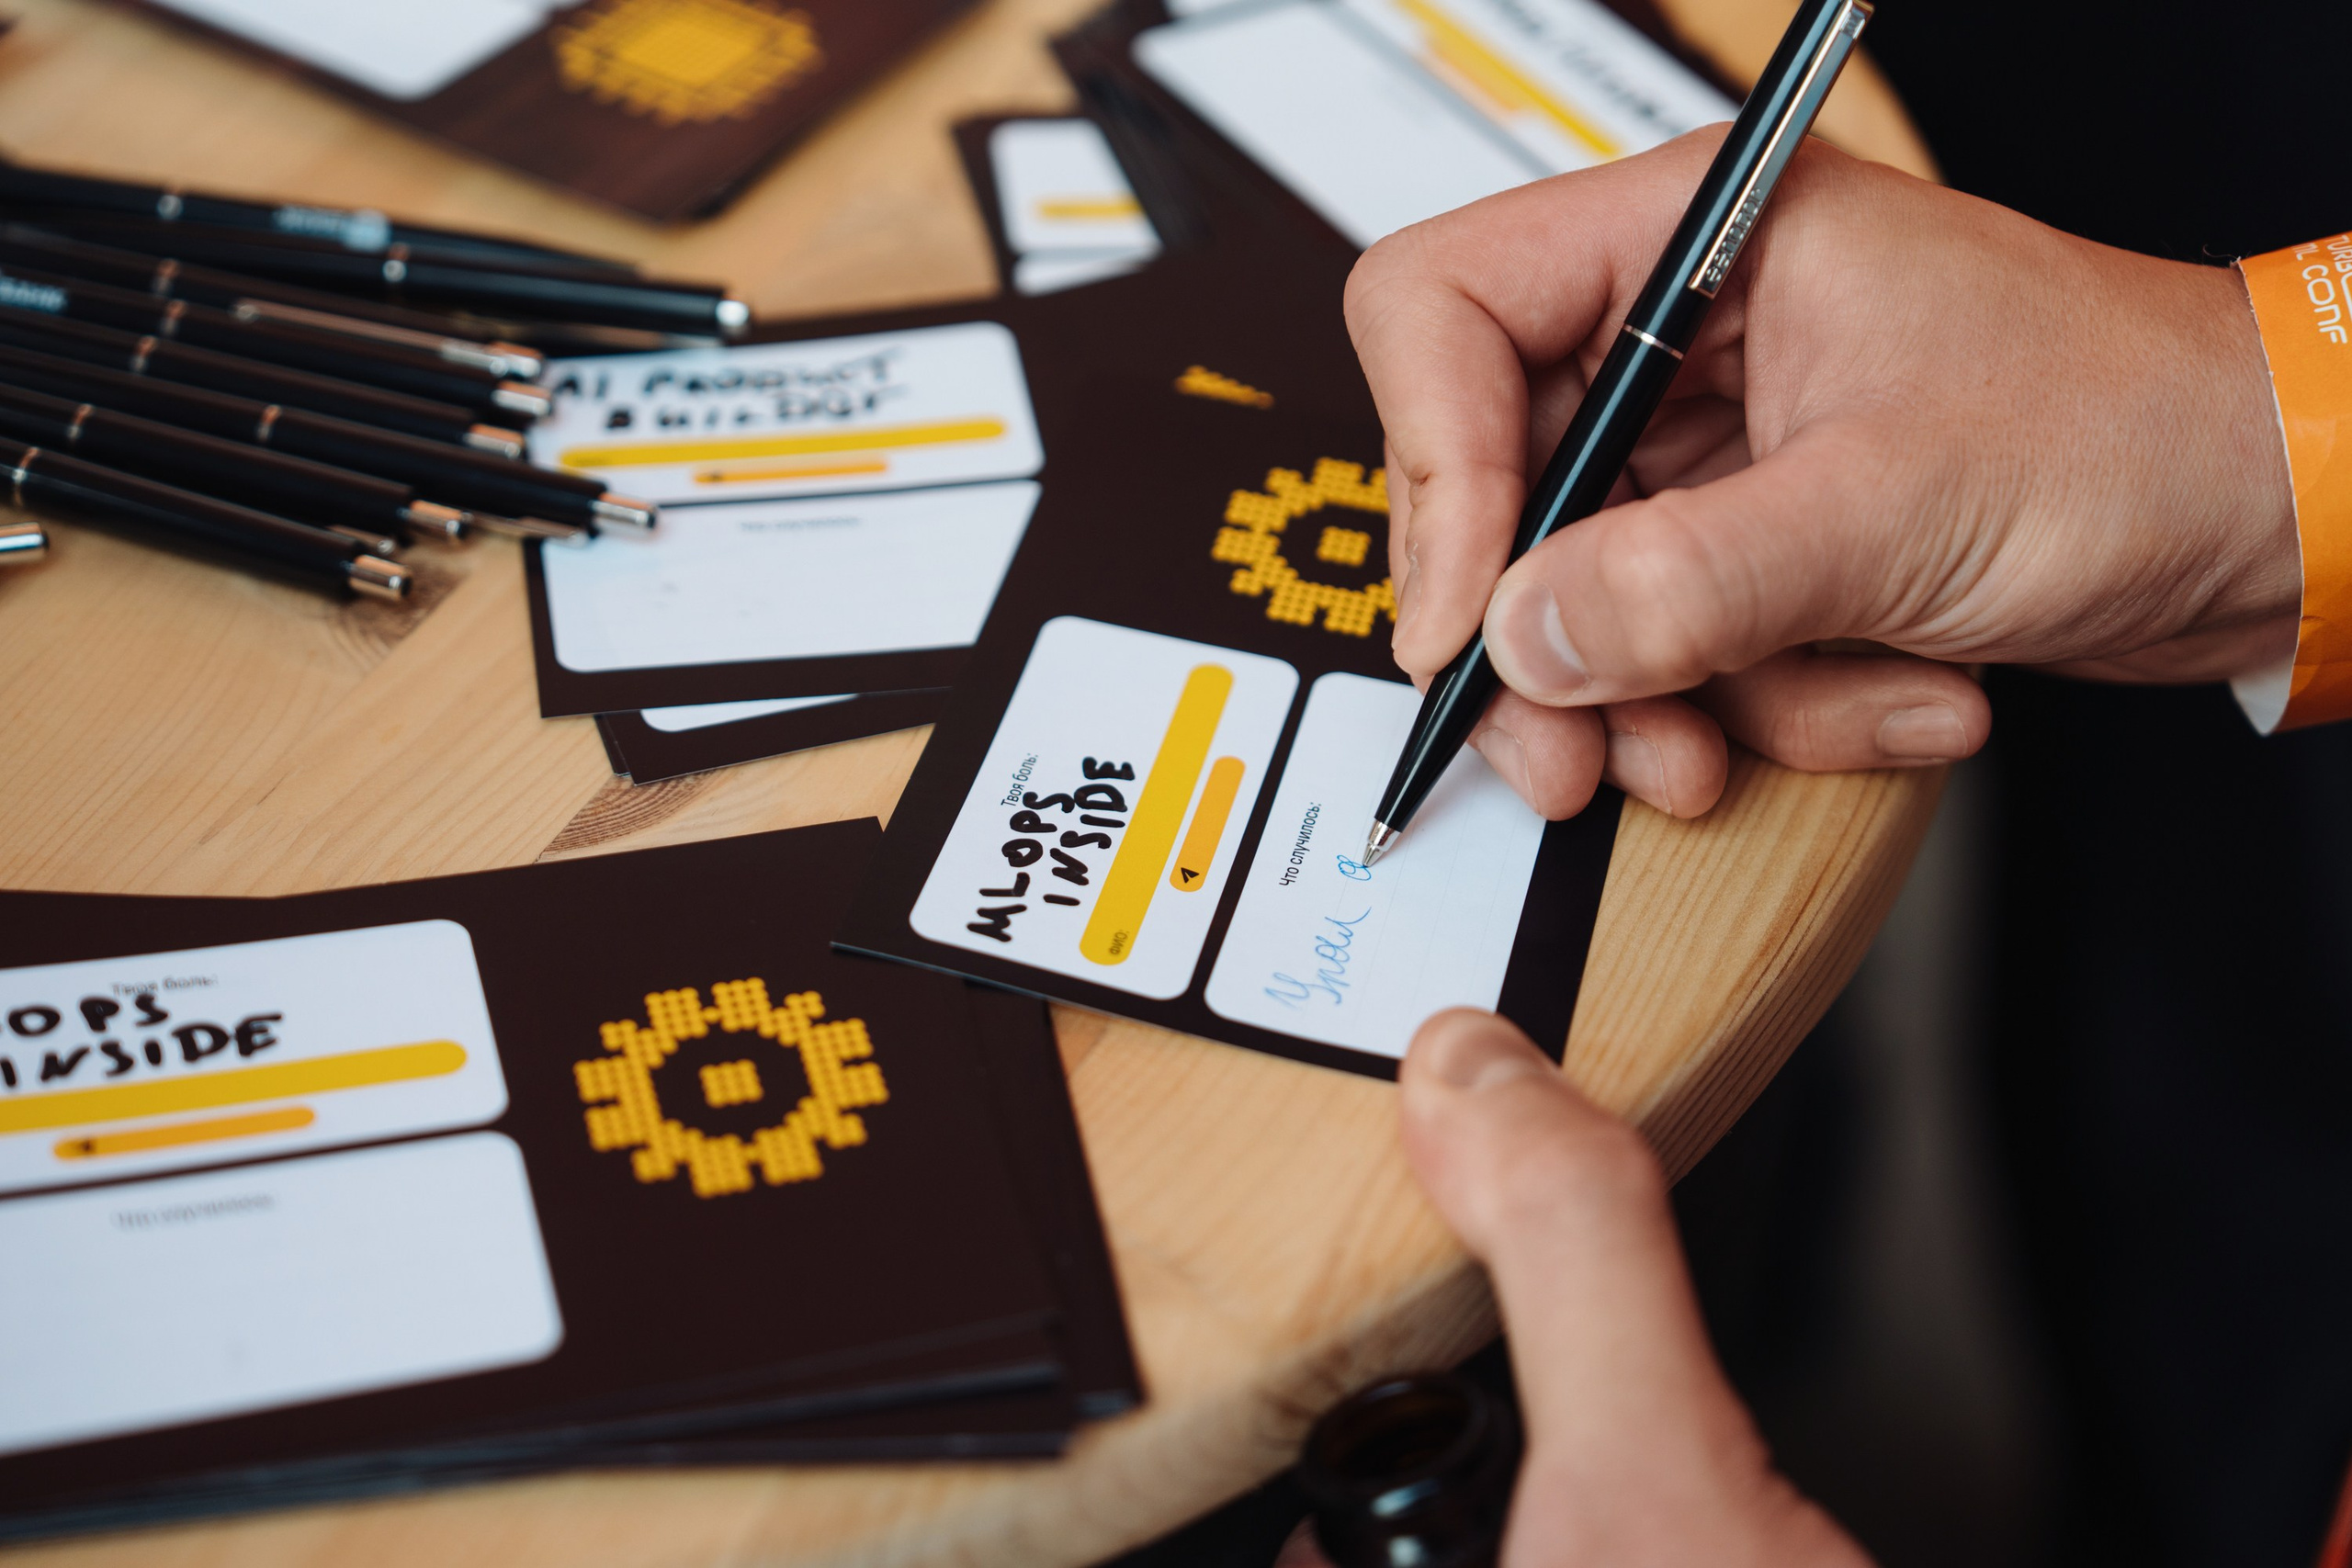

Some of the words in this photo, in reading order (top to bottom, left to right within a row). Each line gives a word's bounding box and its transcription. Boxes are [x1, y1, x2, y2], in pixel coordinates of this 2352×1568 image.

[2301, 264, 2348, 344] CONF
[1001, 782, 1024, 807] Твоя
[1018, 752, 1039, 783] боль:
[1043, 756, 1136, 907] INSIDE
[1289, 801, 1322, 864] случилось:
[967, 791, 1076, 942] MLOPS
[1279, 866, 1300, 886] Что
[0, 992, 170, 1038] OPS
[0, 1013, 283, 1088] INSIDE
